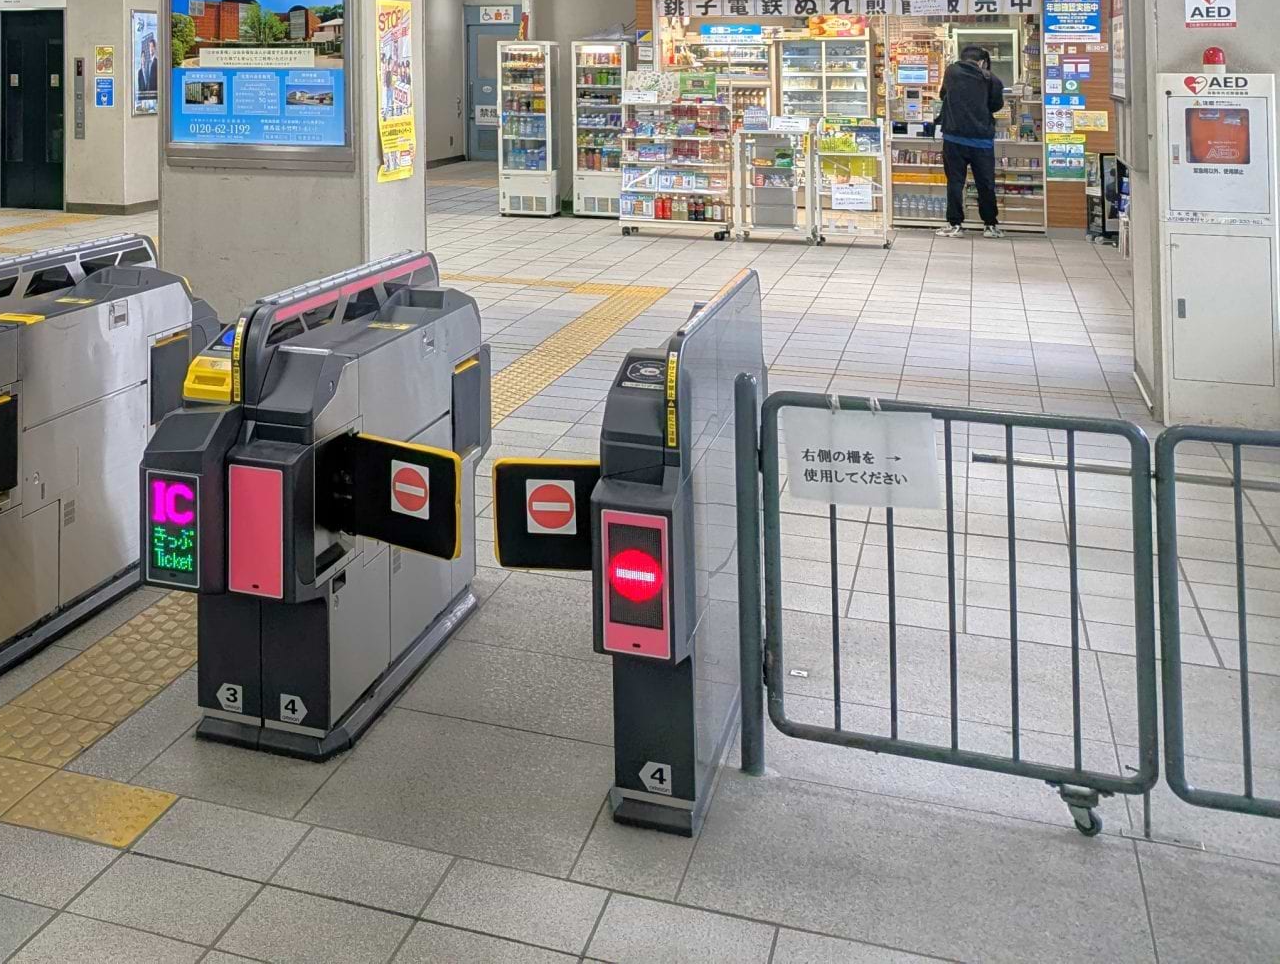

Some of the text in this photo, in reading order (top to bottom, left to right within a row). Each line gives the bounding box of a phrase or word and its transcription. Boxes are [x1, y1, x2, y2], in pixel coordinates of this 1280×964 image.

[1190, 6, 1231, 18] AED
[1209, 77, 1248, 88] AED
[189, 123, 250, 135] 0120-62-1192
[801, 448, 875, 464] 右側の柵を
[804, 468, 907, 485] 使用してください
[152, 479, 195, 524] IC
[154, 526, 195, 550] きっぷ
[154, 548, 193, 571] Ticket
[225, 687, 238, 703] 3
[284, 699, 298, 715] 4
[650, 767, 667, 785] 4
